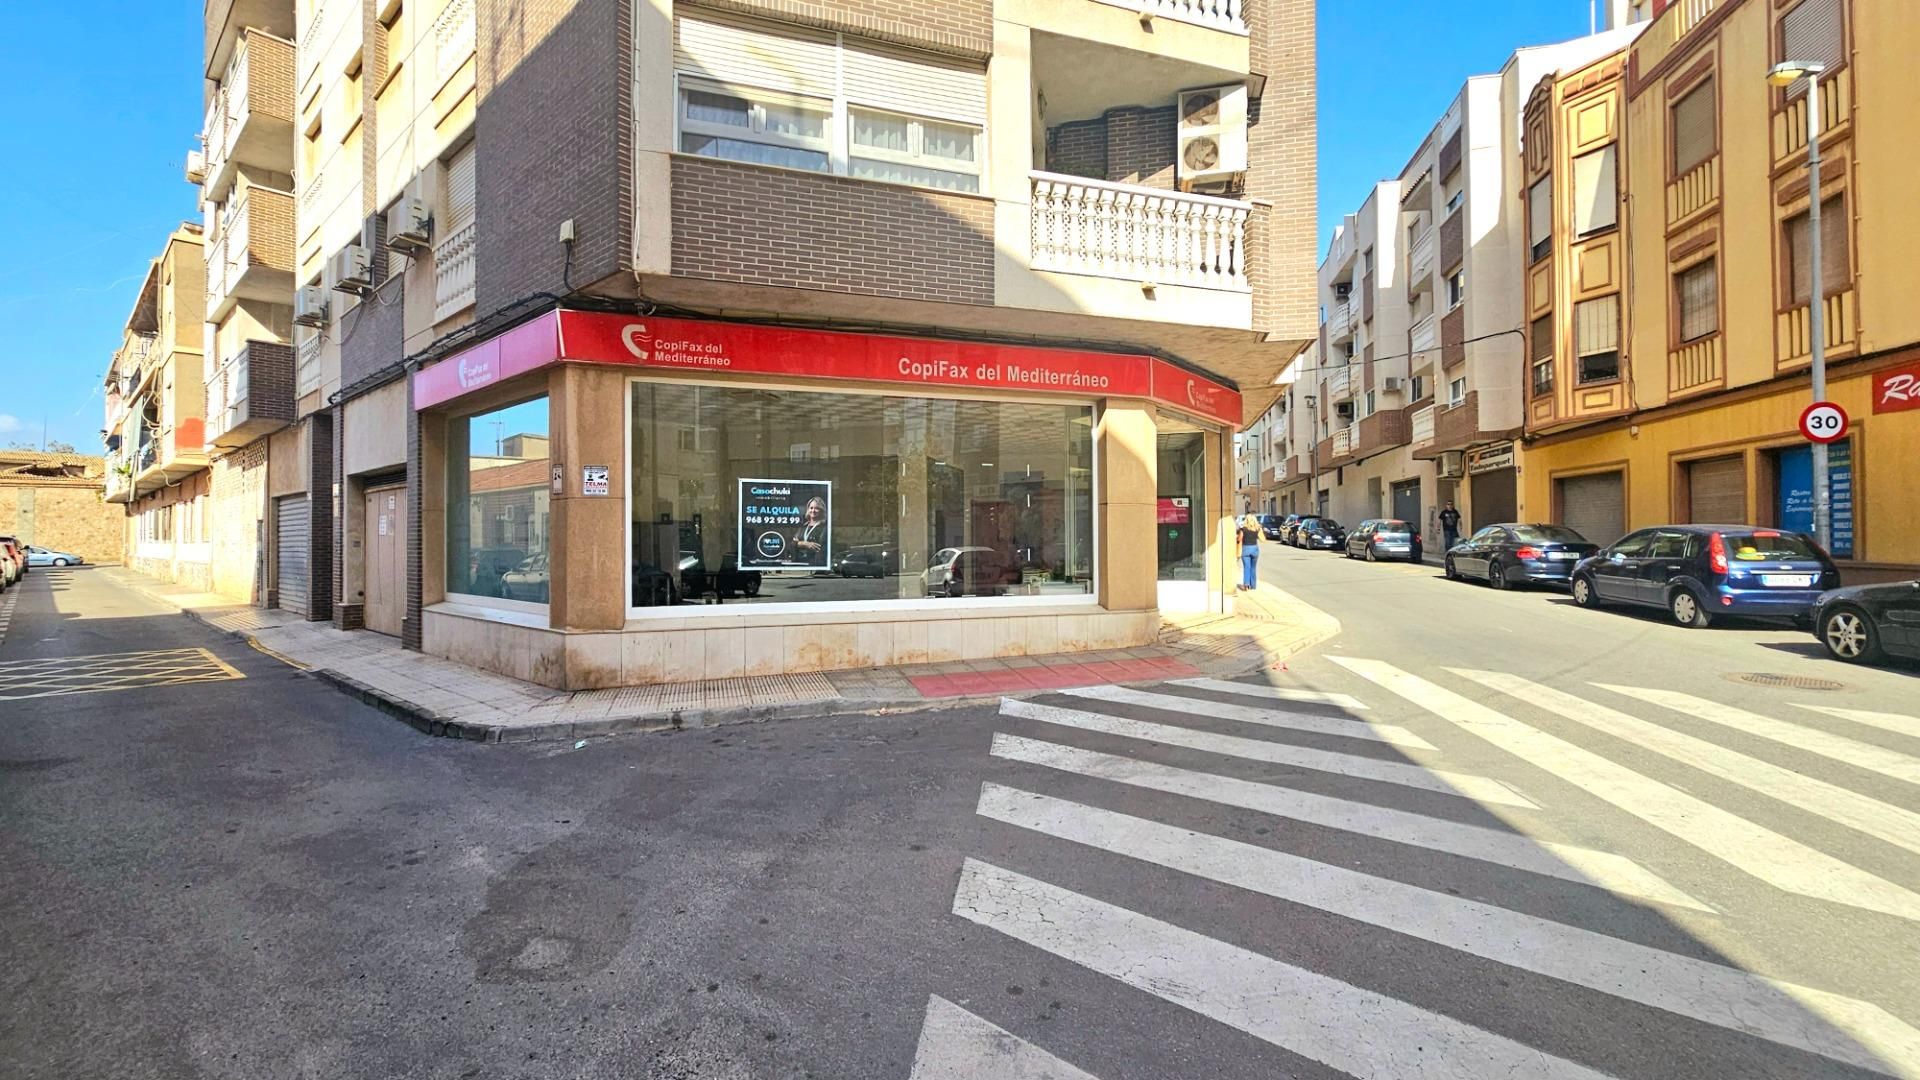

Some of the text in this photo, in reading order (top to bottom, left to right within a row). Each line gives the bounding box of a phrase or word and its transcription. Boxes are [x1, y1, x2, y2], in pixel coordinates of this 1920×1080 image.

[654, 339, 722, 354] CopiFax del
[654, 351, 731, 366] Mediterráneo
[898, 357, 1109, 388] CopiFax del Mediterráneo
[1811, 415, 1839, 429] 30
[746, 506, 800, 515] SE ALQUILA
[745, 516, 762, 524] 968
[764, 516, 775, 524] 92
[776, 516, 788, 524] 92
